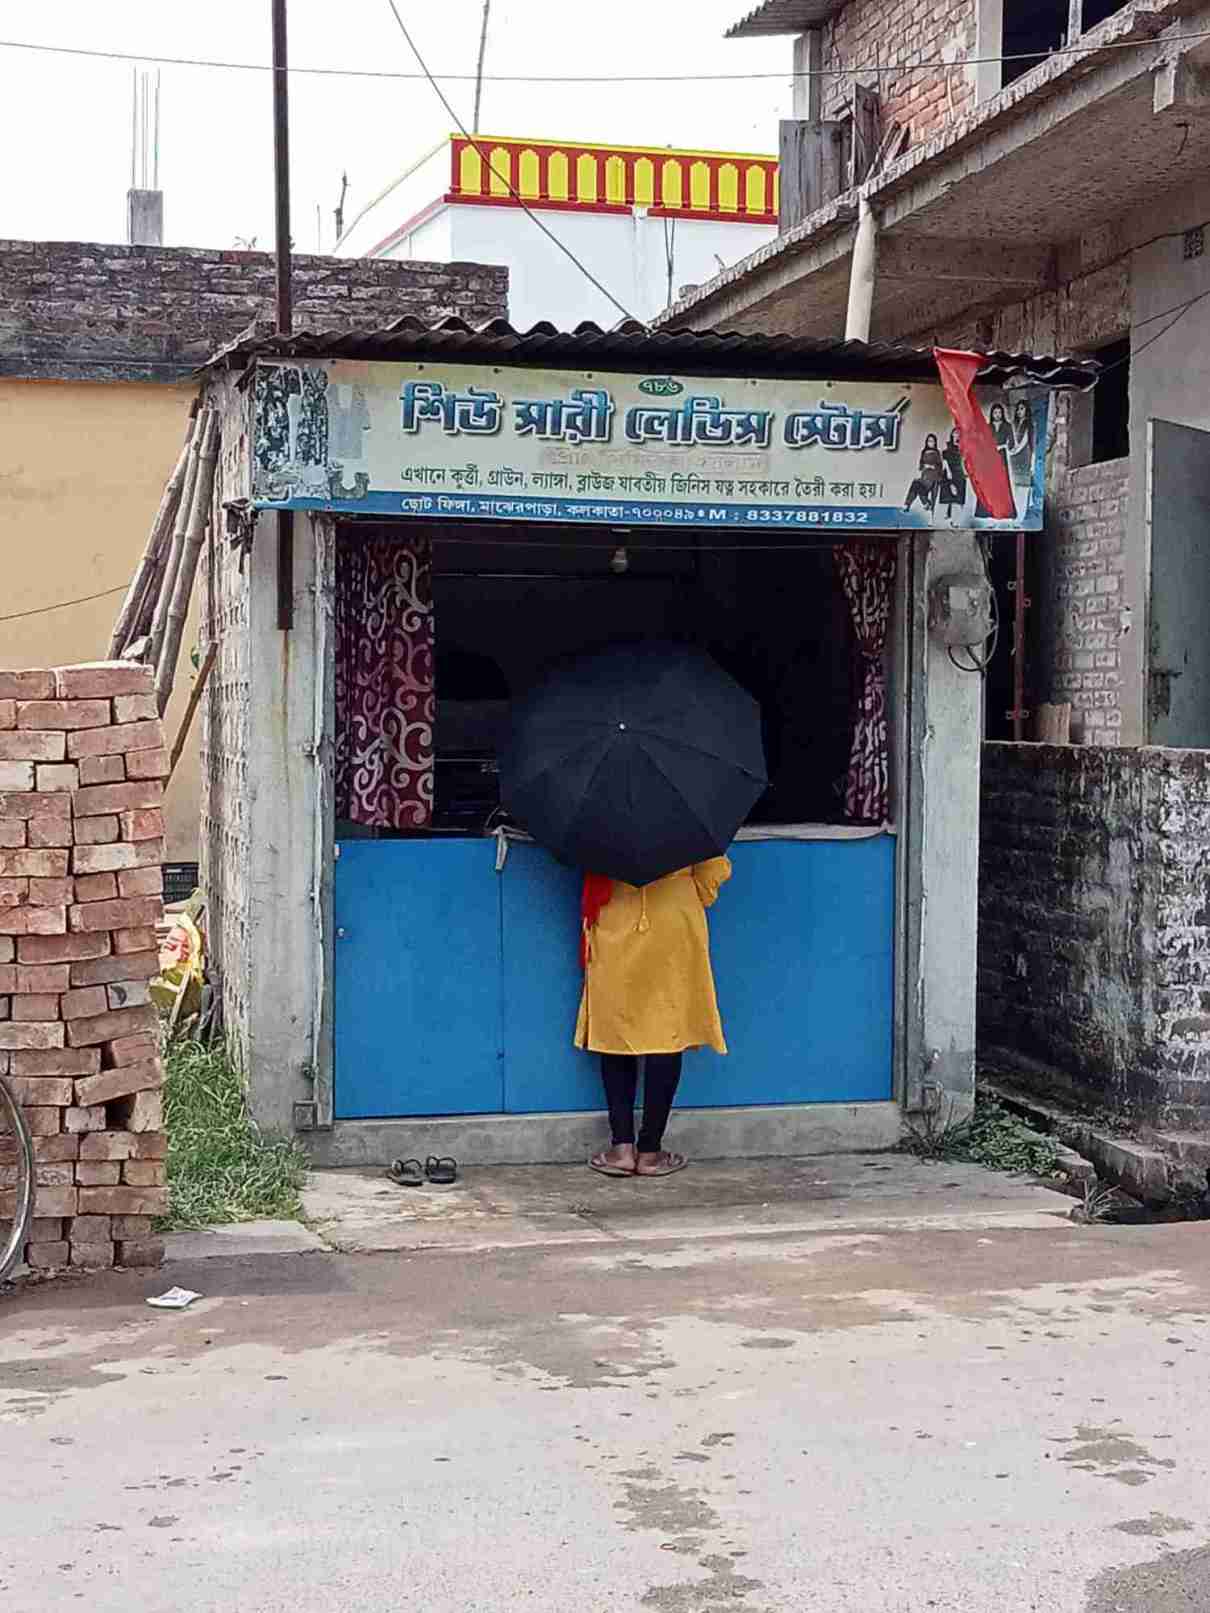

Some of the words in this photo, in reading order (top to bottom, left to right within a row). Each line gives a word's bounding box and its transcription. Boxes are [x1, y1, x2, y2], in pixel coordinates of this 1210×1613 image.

[400, 381, 503, 435] শিউ
[624, 396, 774, 446] লেডিস
[401, 467, 446, 484] এখানে
[576, 471, 616, 494] ব্লাউজ
[671, 472, 710, 495] জিনিস
[738, 479, 790, 498] সহকারে
[828, 482, 855, 499] করা
[746, 511, 869, 523] 8337881832
